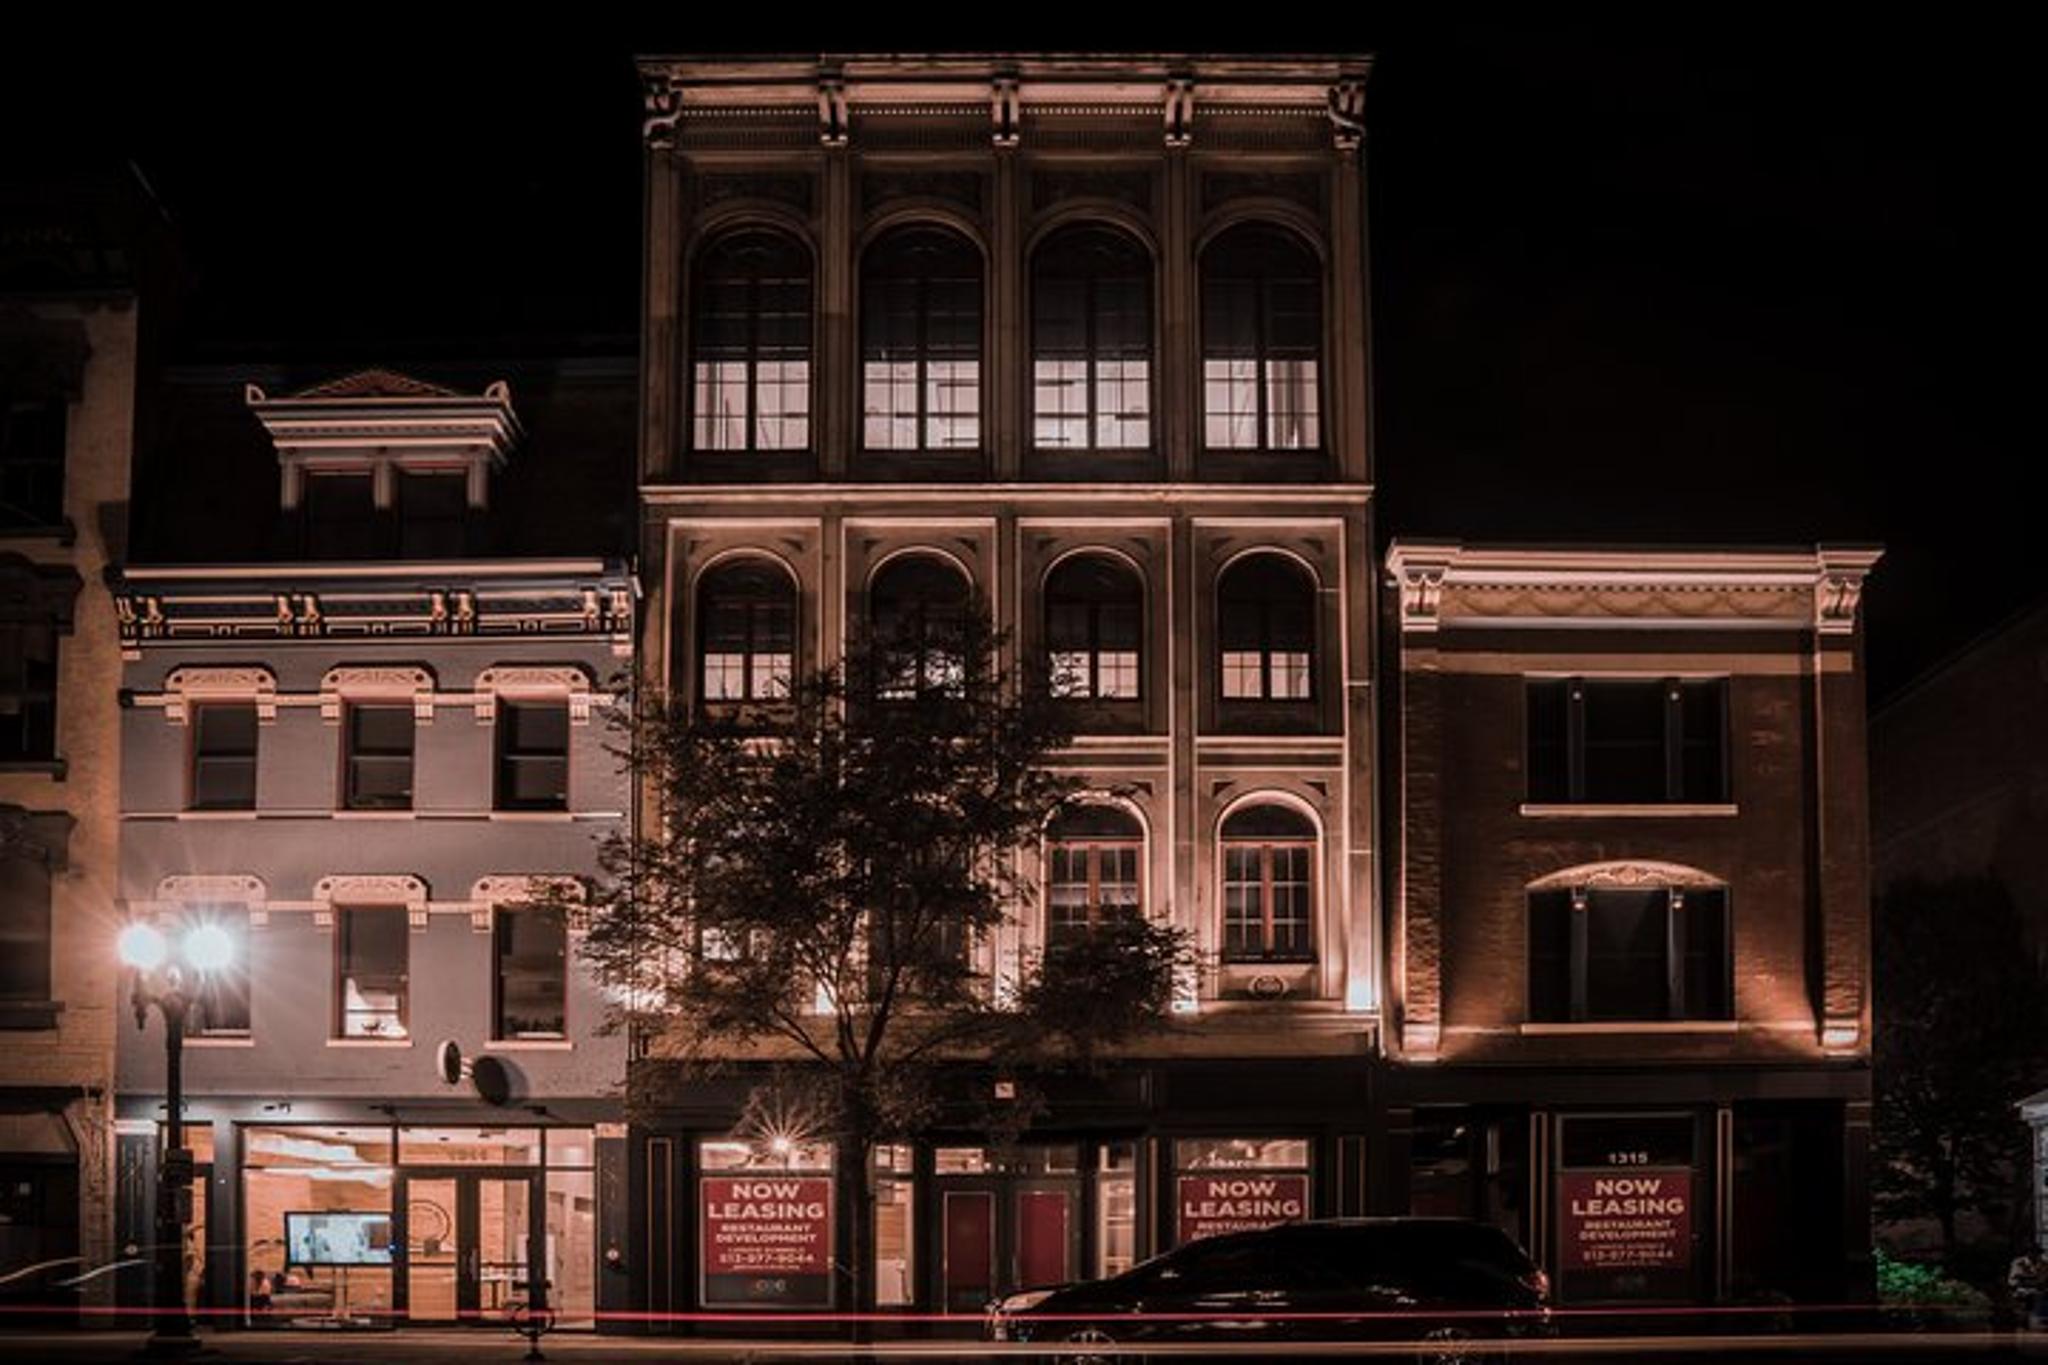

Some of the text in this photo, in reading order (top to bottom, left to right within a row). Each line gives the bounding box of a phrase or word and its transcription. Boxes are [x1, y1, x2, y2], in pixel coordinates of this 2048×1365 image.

[732, 1182, 799, 1198] NOW
[1208, 1181, 1276, 1197] NOW
[1595, 1179, 1662, 1196] NOW
[708, 1202, 825, 1219] LEASING
[1185, 1200, 1300, 1217] LEASING
[1572, 1198, 1685, 1215] LEASING
[721, 1223, 811, 1232] RESTAURANT
[1584, 1219, 1672, 1230] RESTAURANT
[716, 1233, 817, 1243] DEVELOPMENT
[1579, 1230, 1676, 1241] DEVELOPMENT
